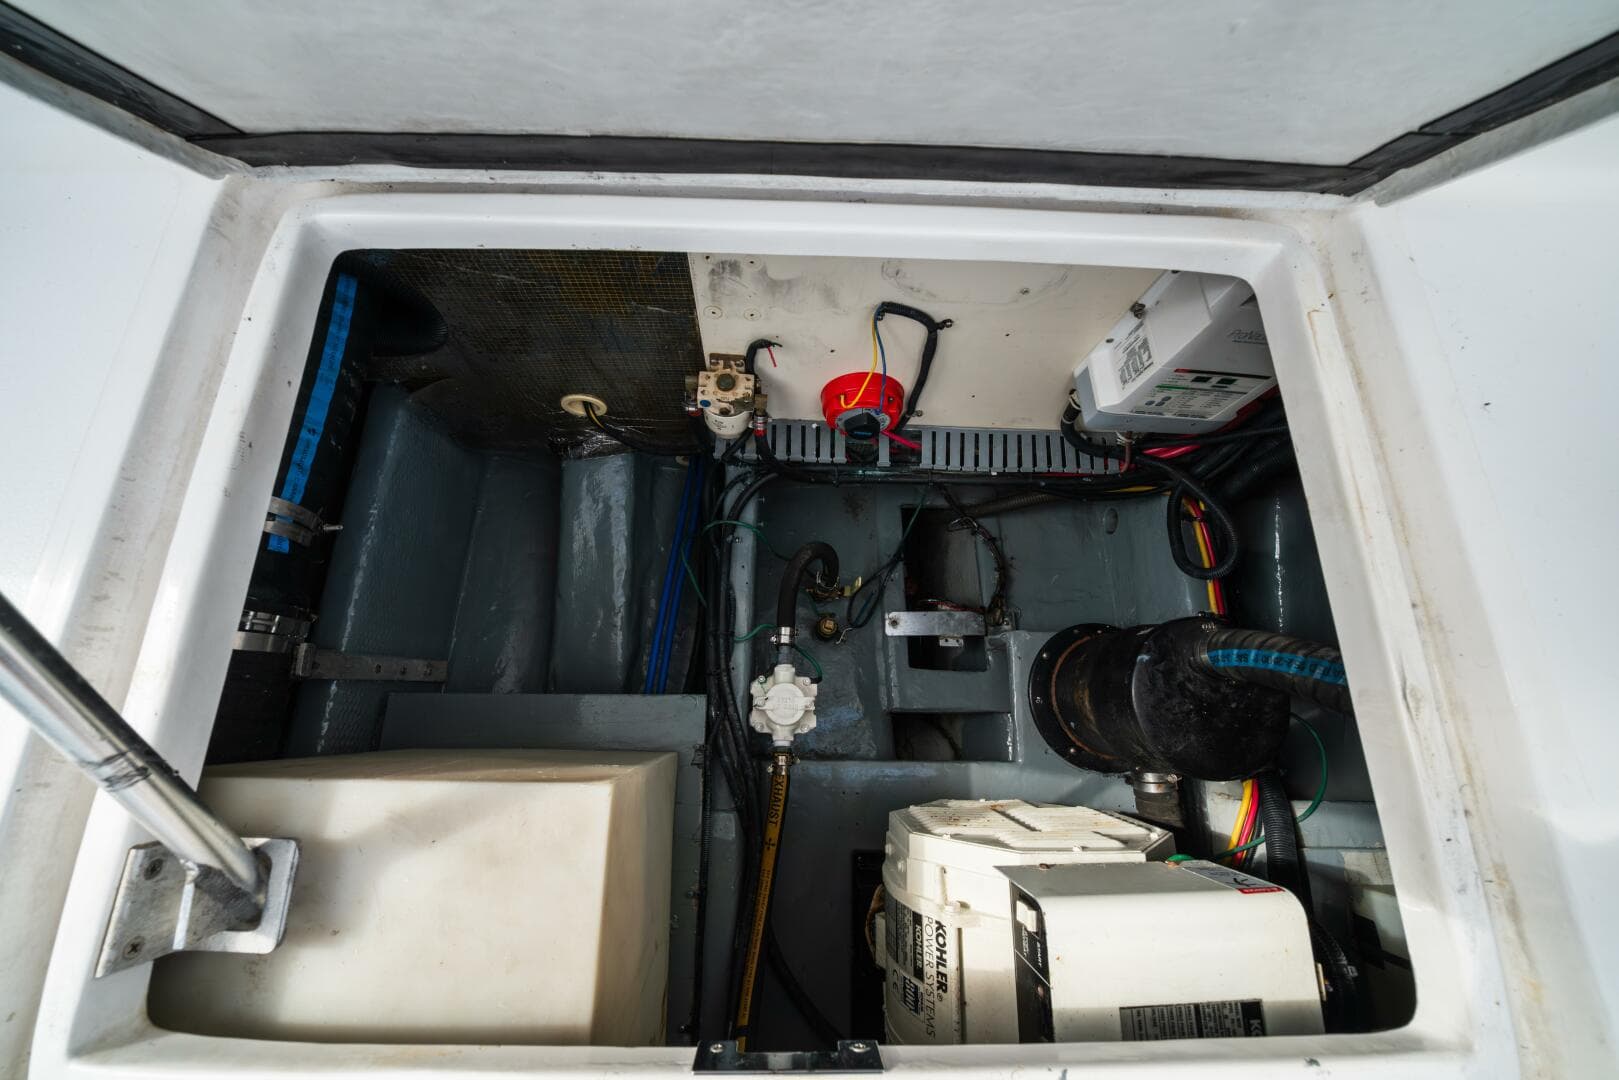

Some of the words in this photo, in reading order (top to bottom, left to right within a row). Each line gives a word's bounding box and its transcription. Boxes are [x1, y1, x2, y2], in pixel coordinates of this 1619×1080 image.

[768, 773, 785, 826] EXHAUST
[924, 915, 935, 969] POWER
[925, 971, 936, 1038] SYSTEMS
